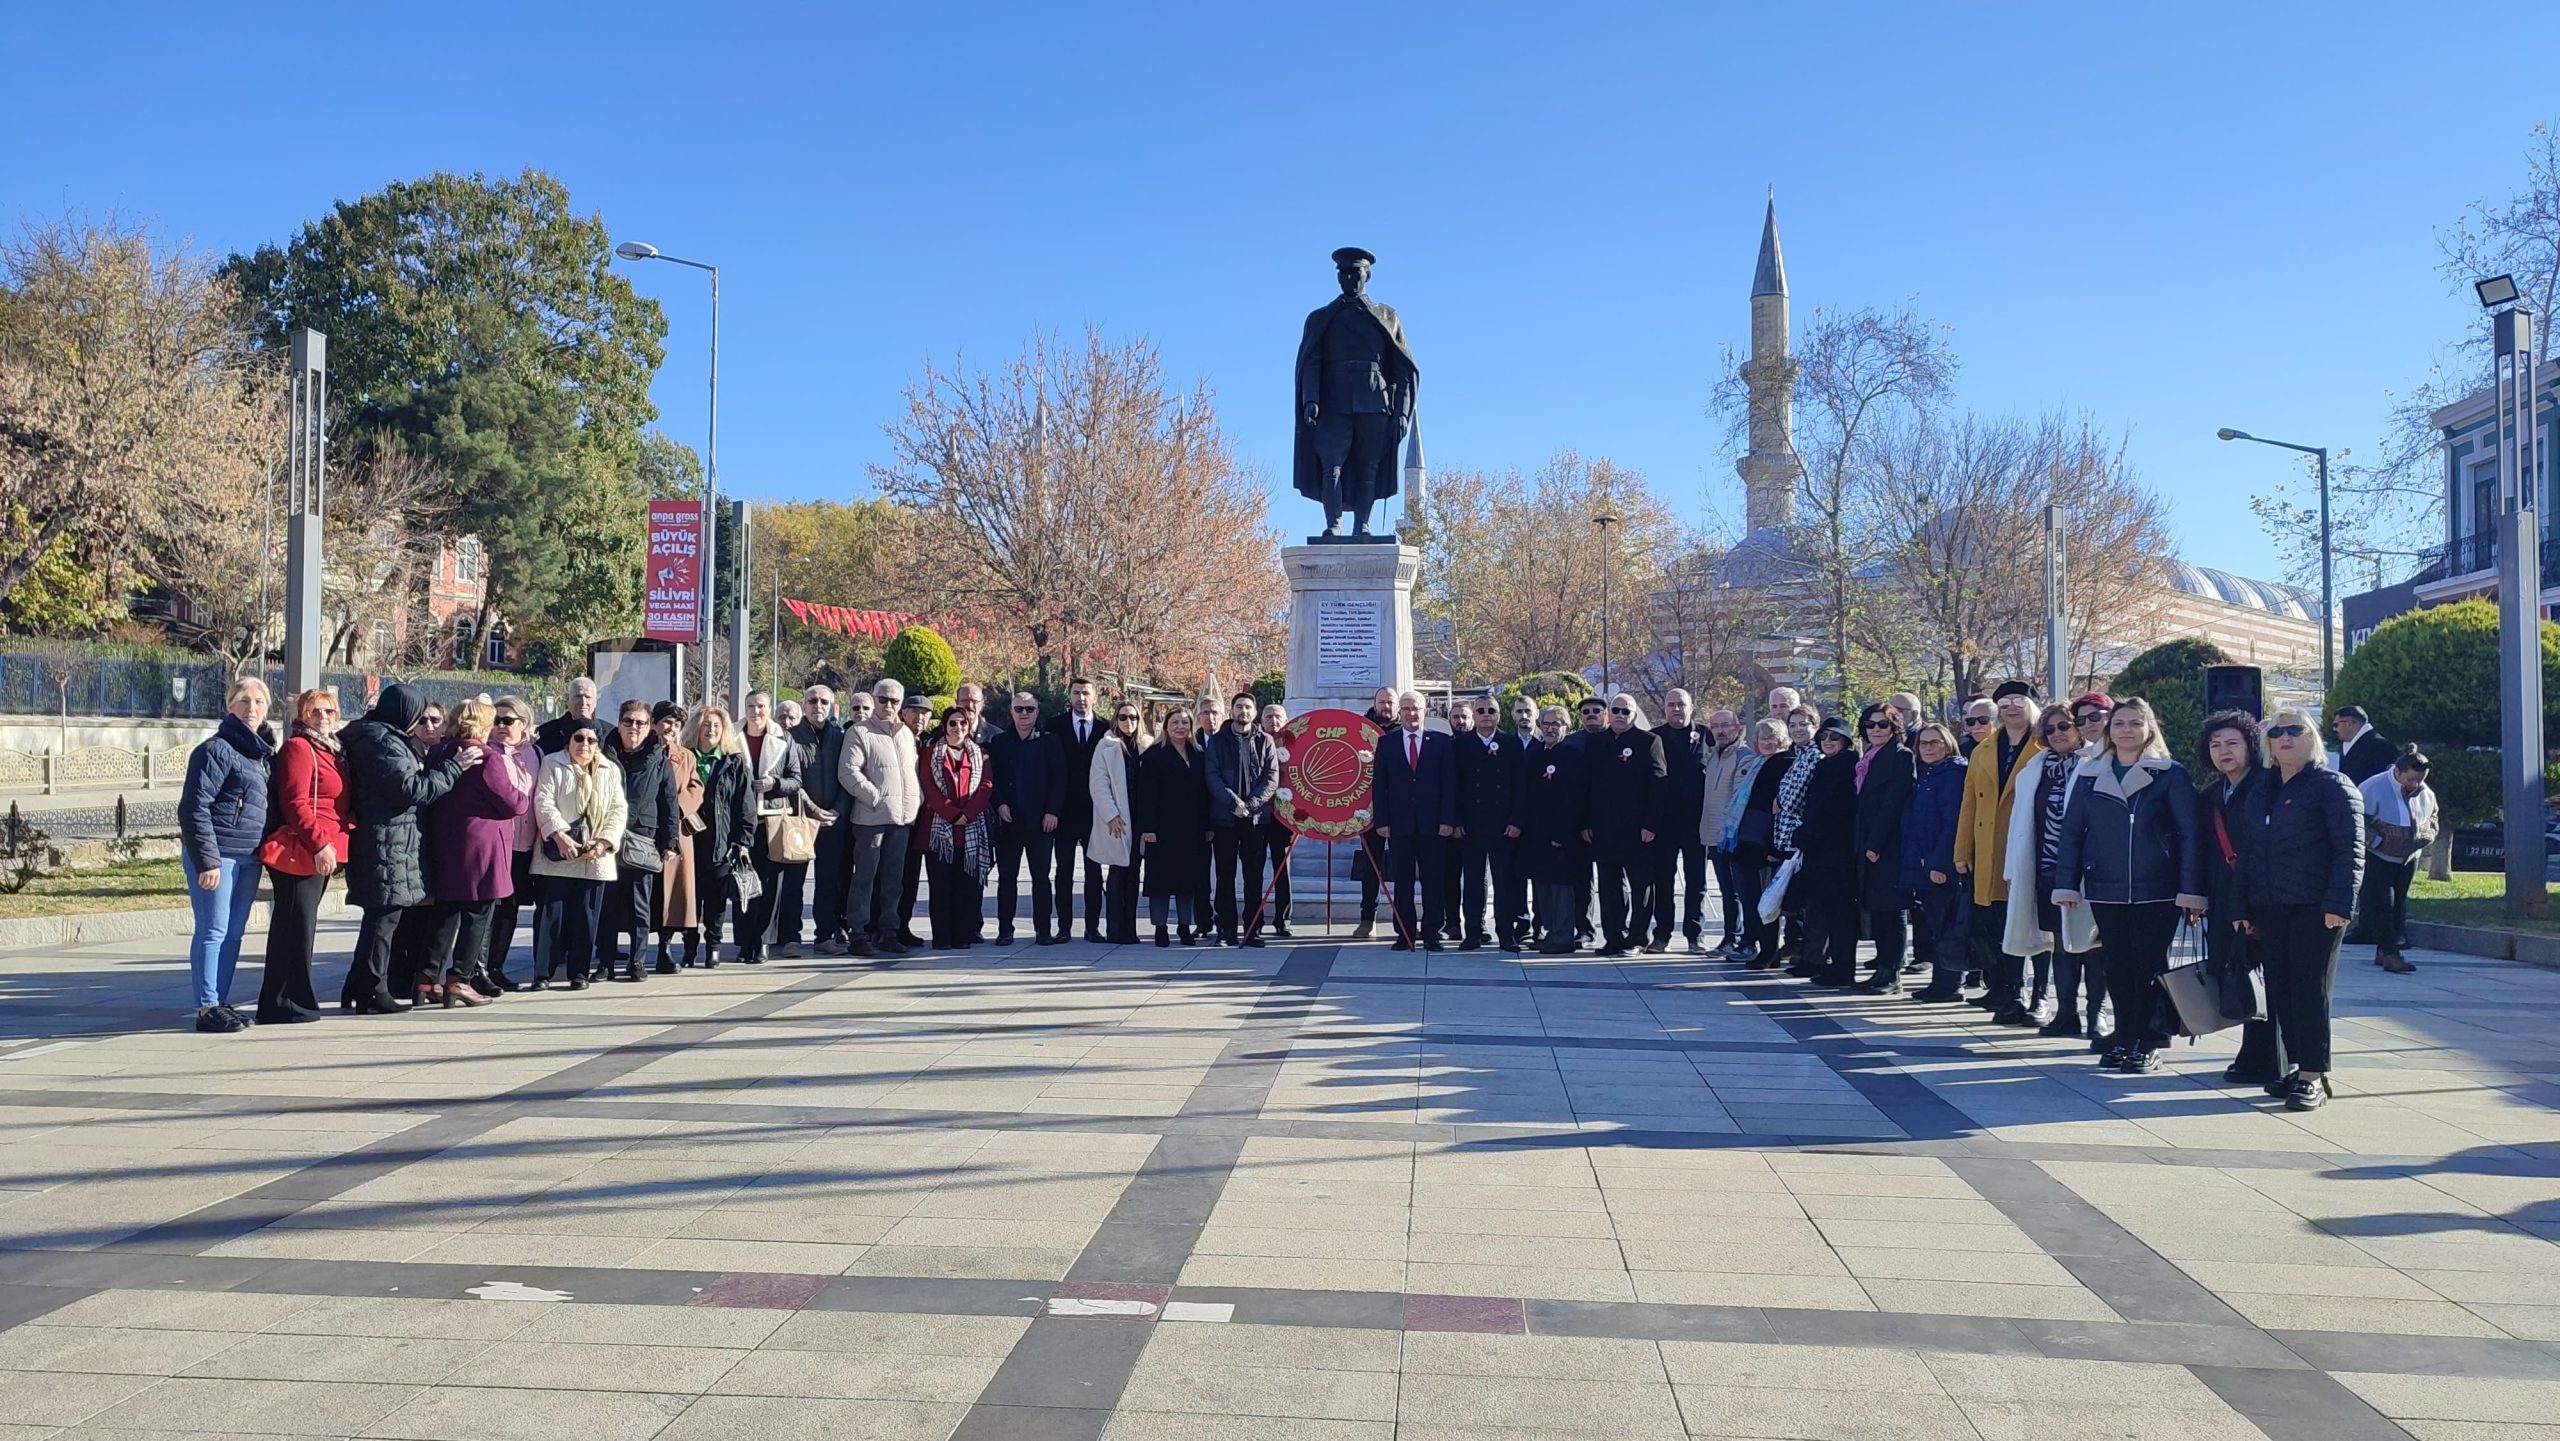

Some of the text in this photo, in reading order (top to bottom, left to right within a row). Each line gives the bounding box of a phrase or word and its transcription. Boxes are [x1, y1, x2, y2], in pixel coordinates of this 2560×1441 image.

[651, 512, 699, 523] anpa gross
[651, 529, 697, 543] BÜYÜK
[651, 543, 696, 558] AÇILIŞ
[649, 587, 695, 601] SİLİVRİ
[648, 612, 695, 621] 30 KASIM
[1315, 727, 1347, 738] CHP
[1288, 764, 1374, 807] EDİRNE İL BAŞKANLIĞI
